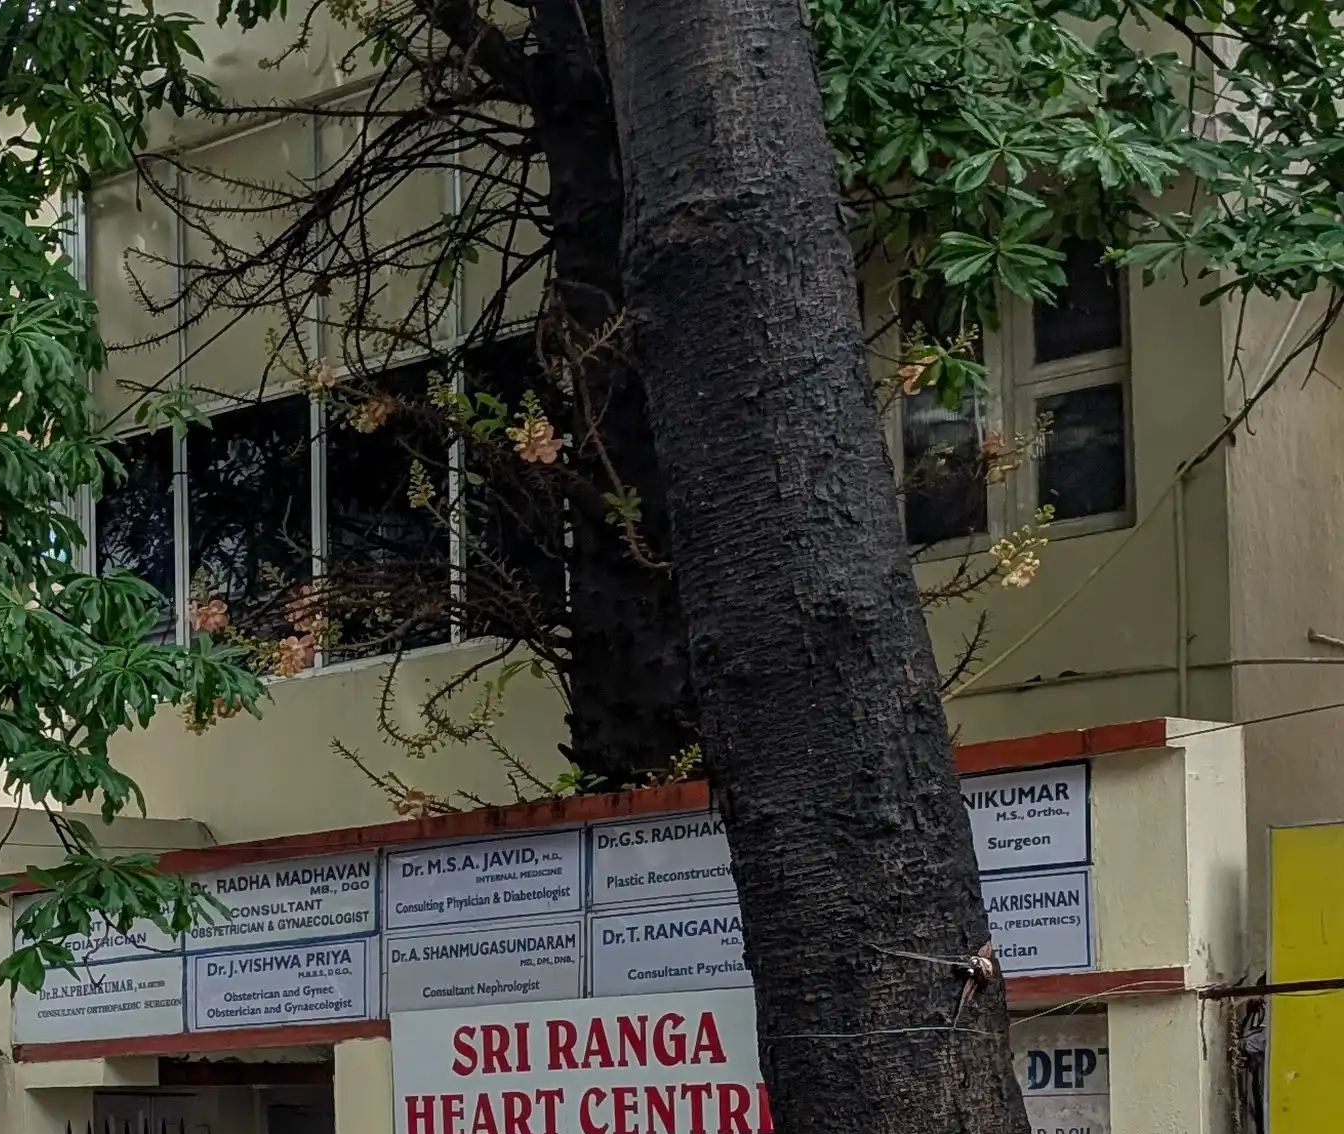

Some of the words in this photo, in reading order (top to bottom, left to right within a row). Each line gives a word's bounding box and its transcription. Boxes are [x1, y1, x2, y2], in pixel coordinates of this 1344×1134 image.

[962, 782, 1070, 810] NIKUMAR
[651, 820, 725, 844] RADHAK
[987, 834, 1051, 851] Surgeon
[402, 862, 424, 878] Dr.
[427, 855, 479, 874] M.S.A.
[482, 847, 539, 872] JAVID,
[216, 873, 271, 894] RADHA
[275, 861, 371, 888] MADHAVAN
[341, 880, 370, 892] DGO
[475, 871, 518, 884] INTERNAL
[519, 866, 563, 879] MEDICINE
[606, 873, 644, 889] Plastic
[647, 863, 733, 884] Reconstructiv
[230, 899, 323, 919] CONSULTANT
[395, 897, 444, 914] Consulting
[446, 894, 490, 911] Physician
[493, 891, 501, 903] &
[503, 885, 571, 903] Diabetologist
[986, 889, 1080, 913] AKRISHNAN
[191, 922, 264, 939] OBSTETRICIAN
[267, 920, 274, 932] &
[277, 911, 370, 931] GYNAECOLOGIST
[644, 916, 743, 941] RANGANA
[1004, 915, 1081, 931] (PEDIATRICS)
[306, 949, 352, 967] PRIYA
[422, 933, 576, 961] SHANMUGASUNDARAM
[994, 944, 1038, 958] rician
[627, 965, 693, 980] Consultant
[696, 959, 748, 976] Psychia
[283, 986, 300, 998] and
[302, 986, 334, 1000] Gynec
[422, 984, 475, 999] Consultant
[476, 979, 540, 997] Nephrologist
[37, 1007, 86, 1020] CONSULTANT
[87, 1001, 141, 1015] ORTHOPAEDIC
[144, 998, 182, 1009] SURGEON
[264, 1003, 282, 1015] and
[284, 998, 353, 1015] Gynaecologist
[452, 1022, 531, 1076] SRI
[546, 1011, 728, 1071] RANGA
